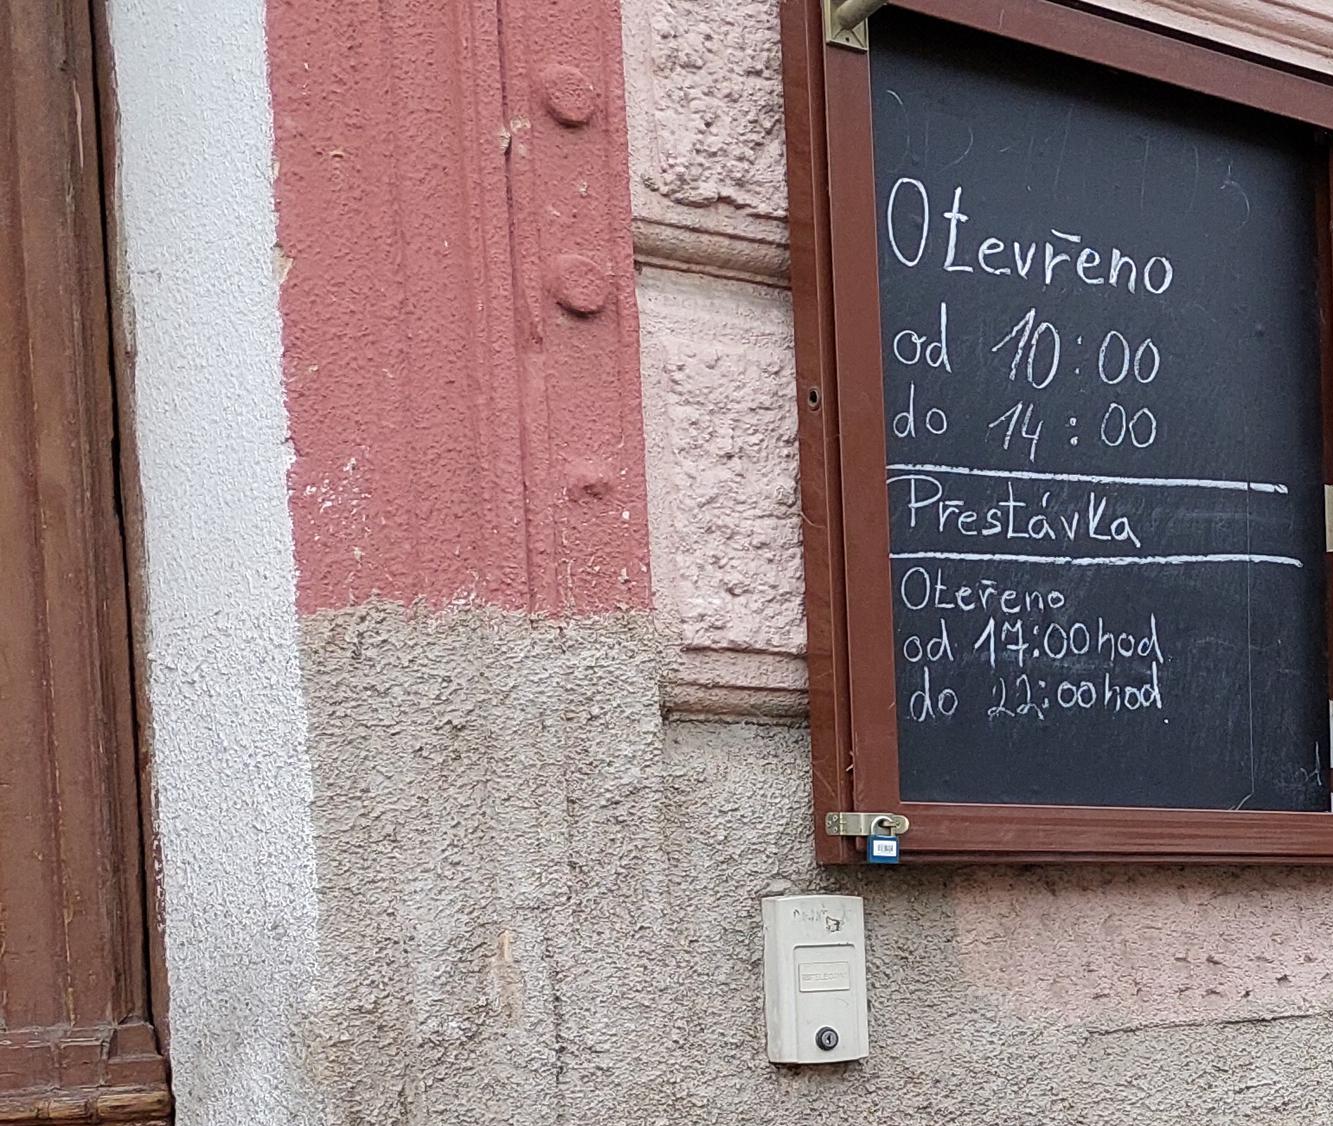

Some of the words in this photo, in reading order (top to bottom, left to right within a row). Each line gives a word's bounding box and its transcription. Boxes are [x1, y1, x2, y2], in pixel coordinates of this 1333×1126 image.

[887, 177, 1174, 294] Otevřeno
[893, 302, 952, 373] od
[892, 381, 948, 438] do
[903, 618, 954, 662] od
[909, 667, 958, 722] do
